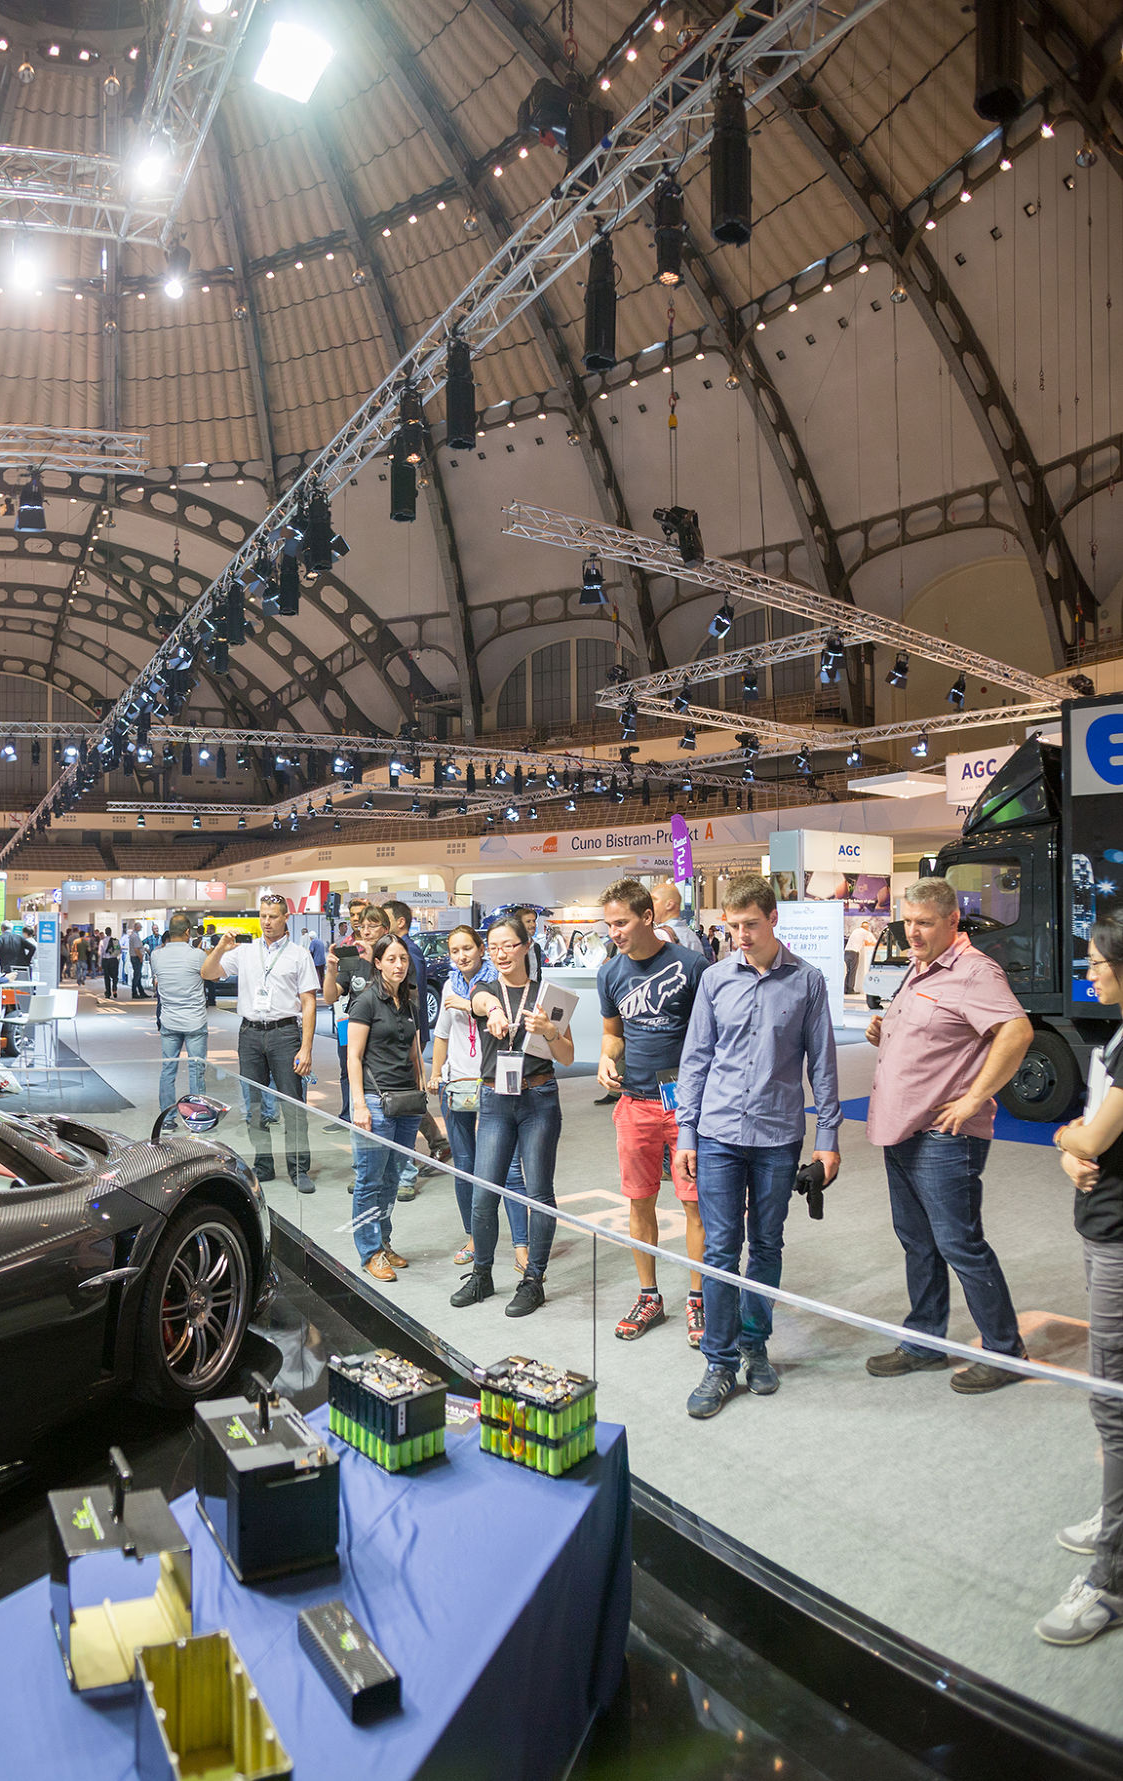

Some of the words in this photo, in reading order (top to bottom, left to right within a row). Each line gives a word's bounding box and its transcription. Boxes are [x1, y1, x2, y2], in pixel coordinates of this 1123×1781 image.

[961, 758, 997, 780] AGC
[571, 835, 602, 851] Cuno
[606, 826, 699, 848] Bistram-Prokt
[704, 821, 715, 841] A
[838, 844, 861, 857] AGC
[799, 933, 808, 941] App
